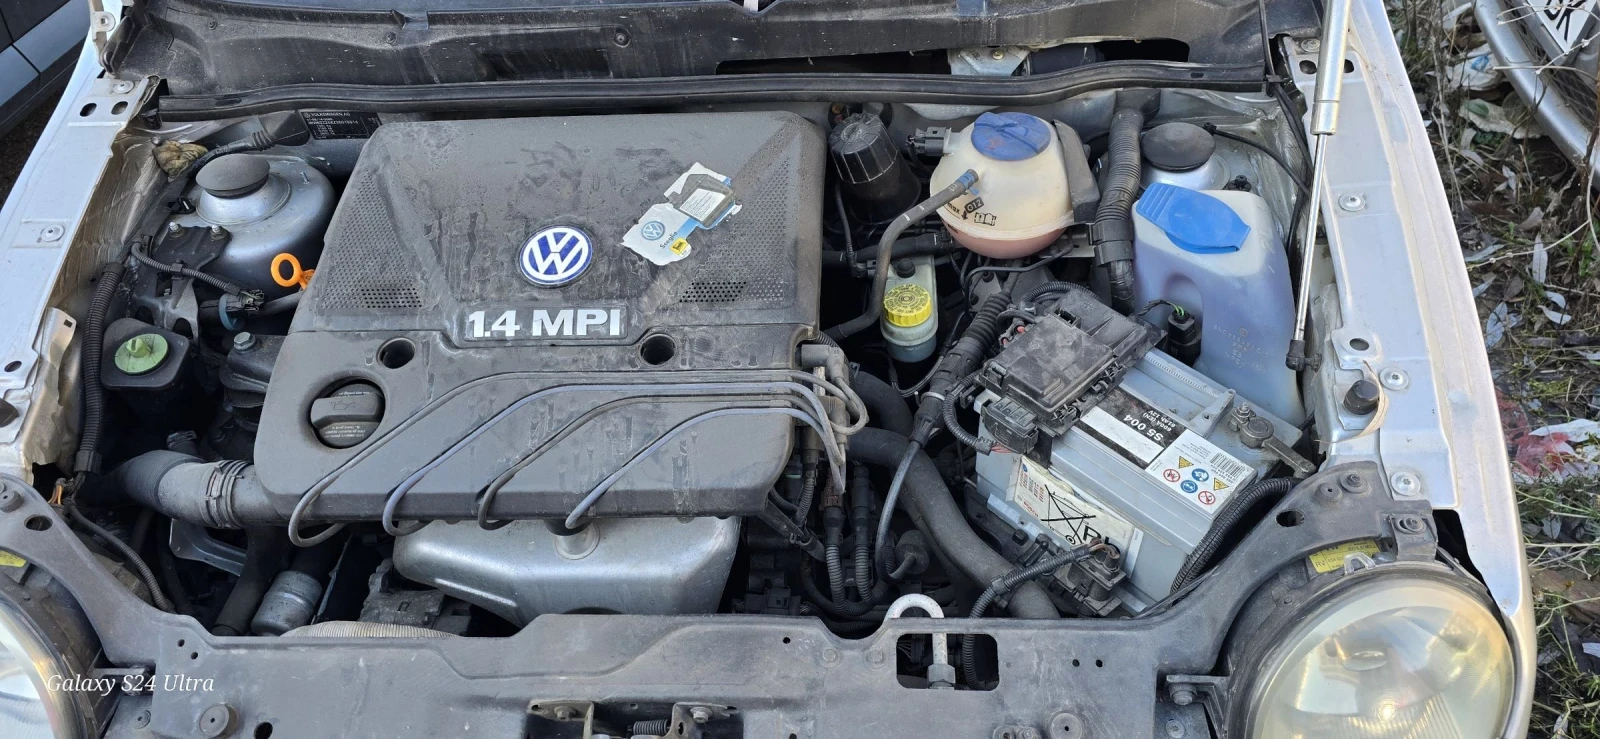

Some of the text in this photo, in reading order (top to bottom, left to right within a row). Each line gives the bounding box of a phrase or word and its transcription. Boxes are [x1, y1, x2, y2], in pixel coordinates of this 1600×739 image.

[966, 199, 984, 212] G12
[468, 309, 621, 338] 1.4 MPI
[1123, 414, 1164, 441] S5 004
